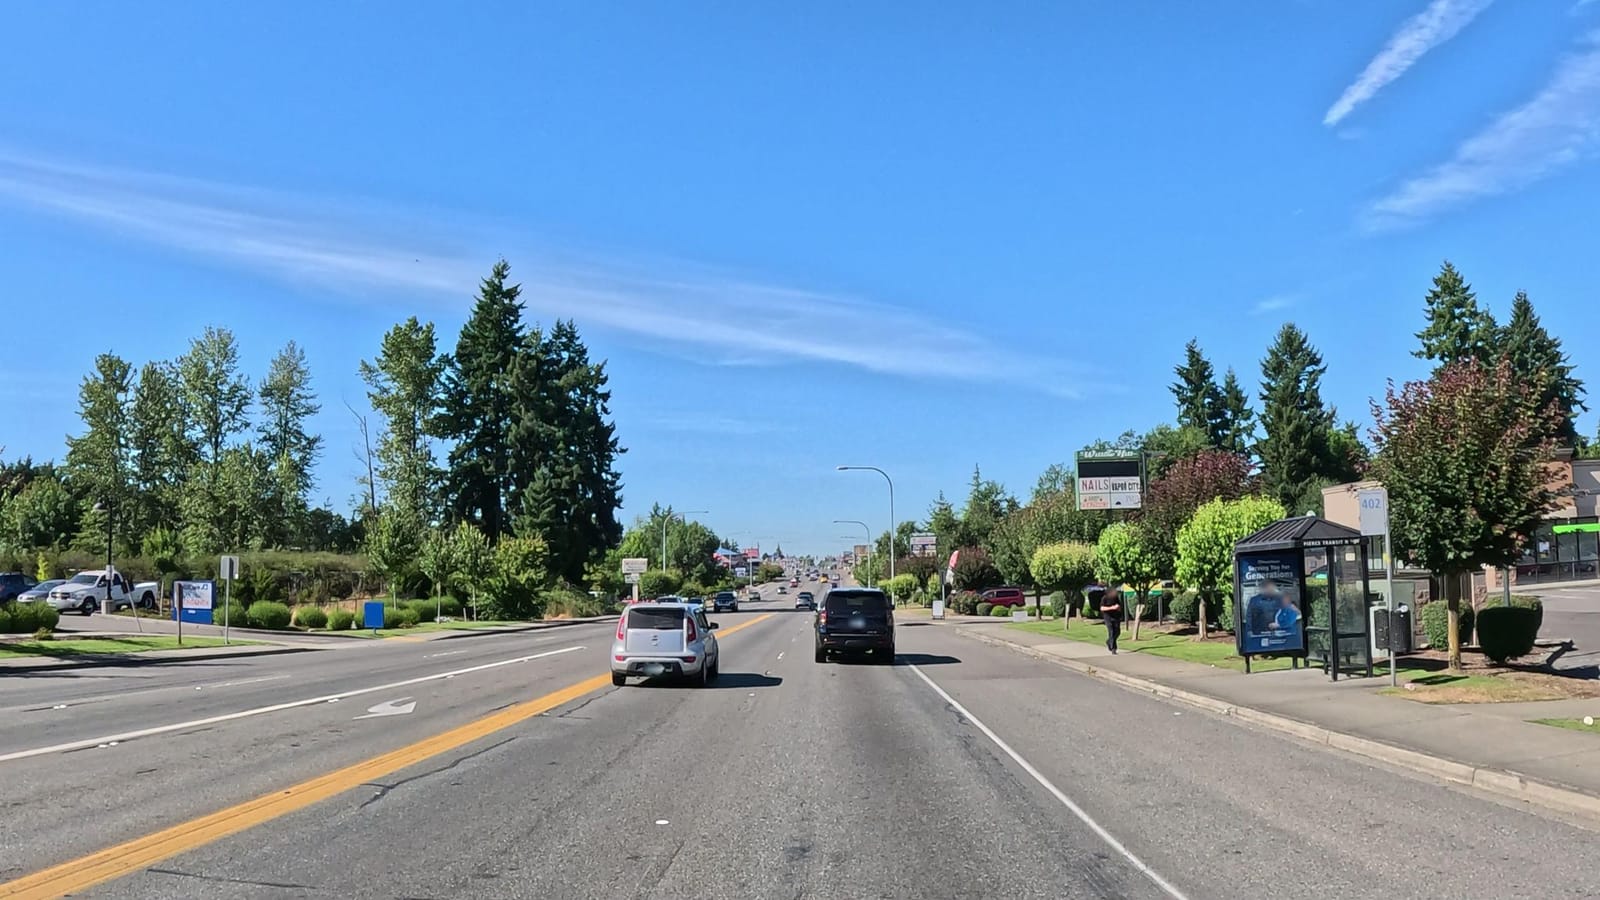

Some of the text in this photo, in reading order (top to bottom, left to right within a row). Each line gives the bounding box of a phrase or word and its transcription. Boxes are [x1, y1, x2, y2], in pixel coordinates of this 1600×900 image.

[1082, 479, 1109, 491] NAILS
[1362, 498, 1381, 509] 402
[1245, 571, 1294, 580] Generations
